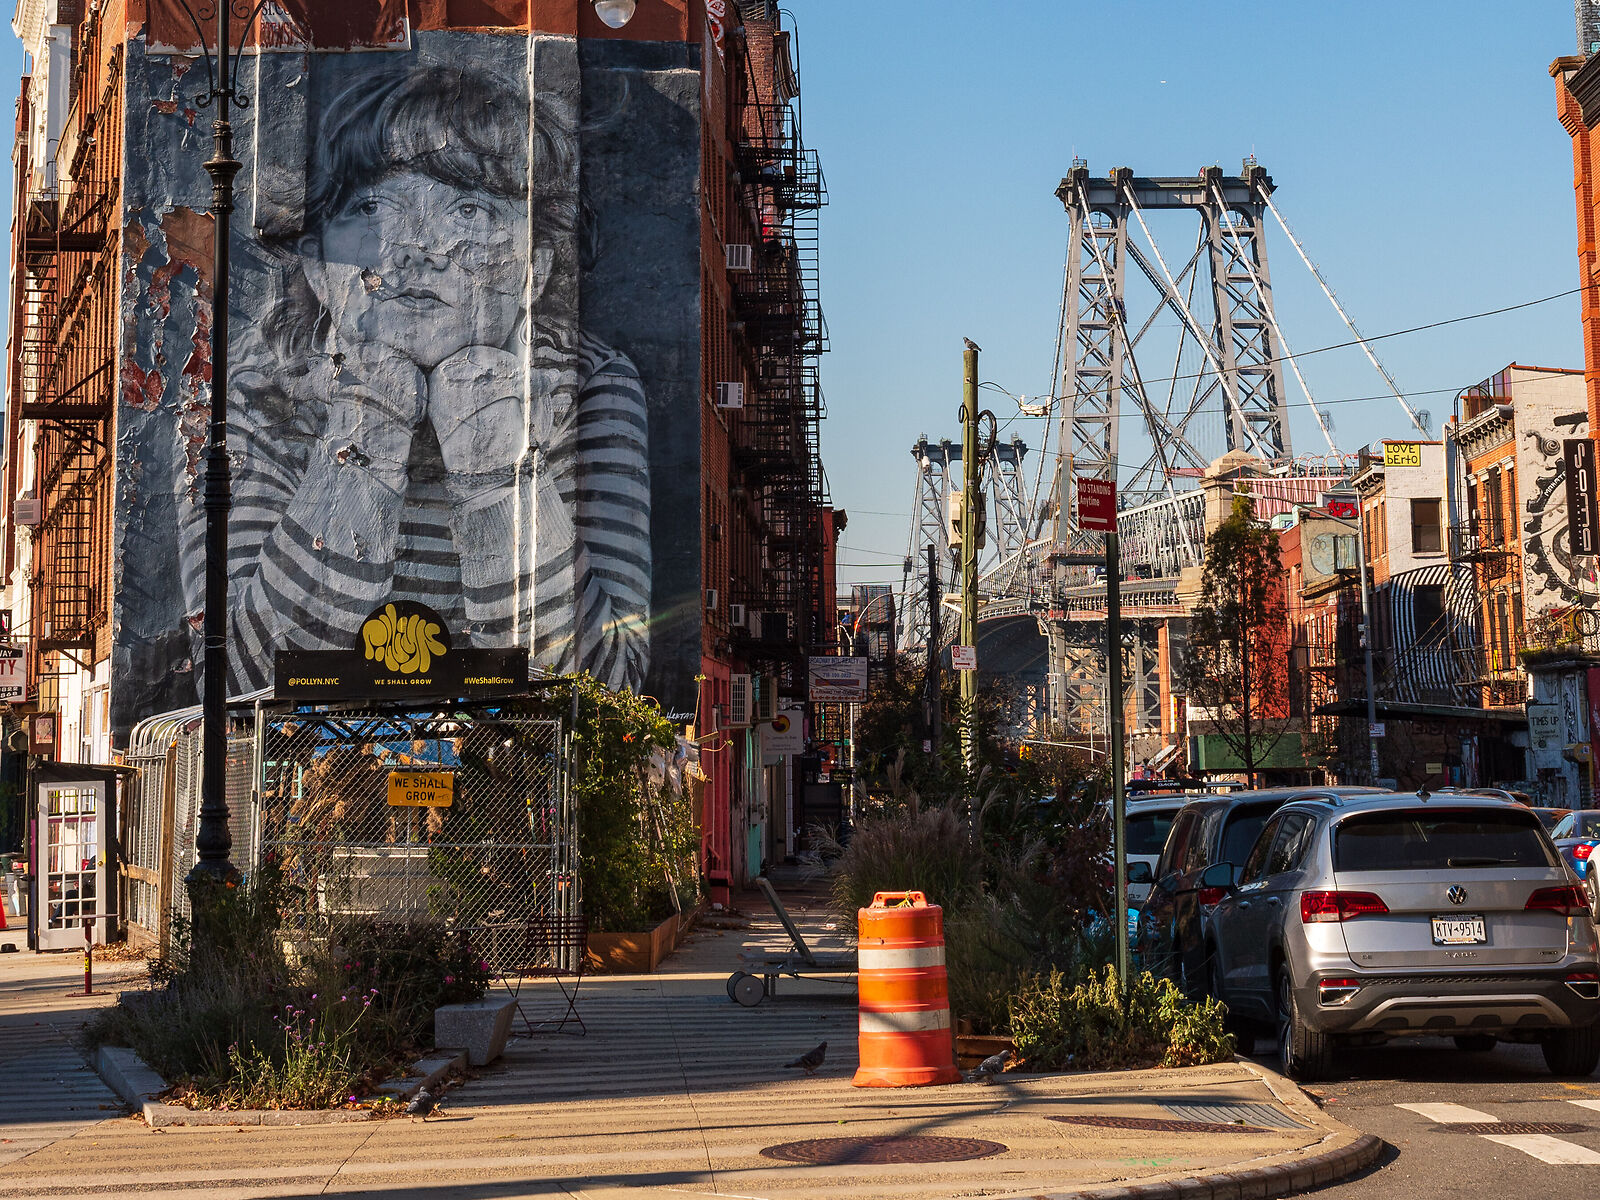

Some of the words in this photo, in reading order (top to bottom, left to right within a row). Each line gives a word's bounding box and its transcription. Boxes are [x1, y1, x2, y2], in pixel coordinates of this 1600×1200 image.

[1386, 444, 1416, 454] LOVE
[1079, 483, 1087, 493] NO
[1087, 483, 1111, 496] STANDING
[288, 677, 340, 687] @POLLYN.NYC
[374, 678, 385, 686] WE
[387, 678, 408, 686] SHALL
[410, 678, 432, 686] GROW
[464, 676, 515, 685] #WeShallGrow
[394, 778, 409, 788] WE
[413, 778, 447, 789] SHALL
[405, 791, 436, 801] GROW
